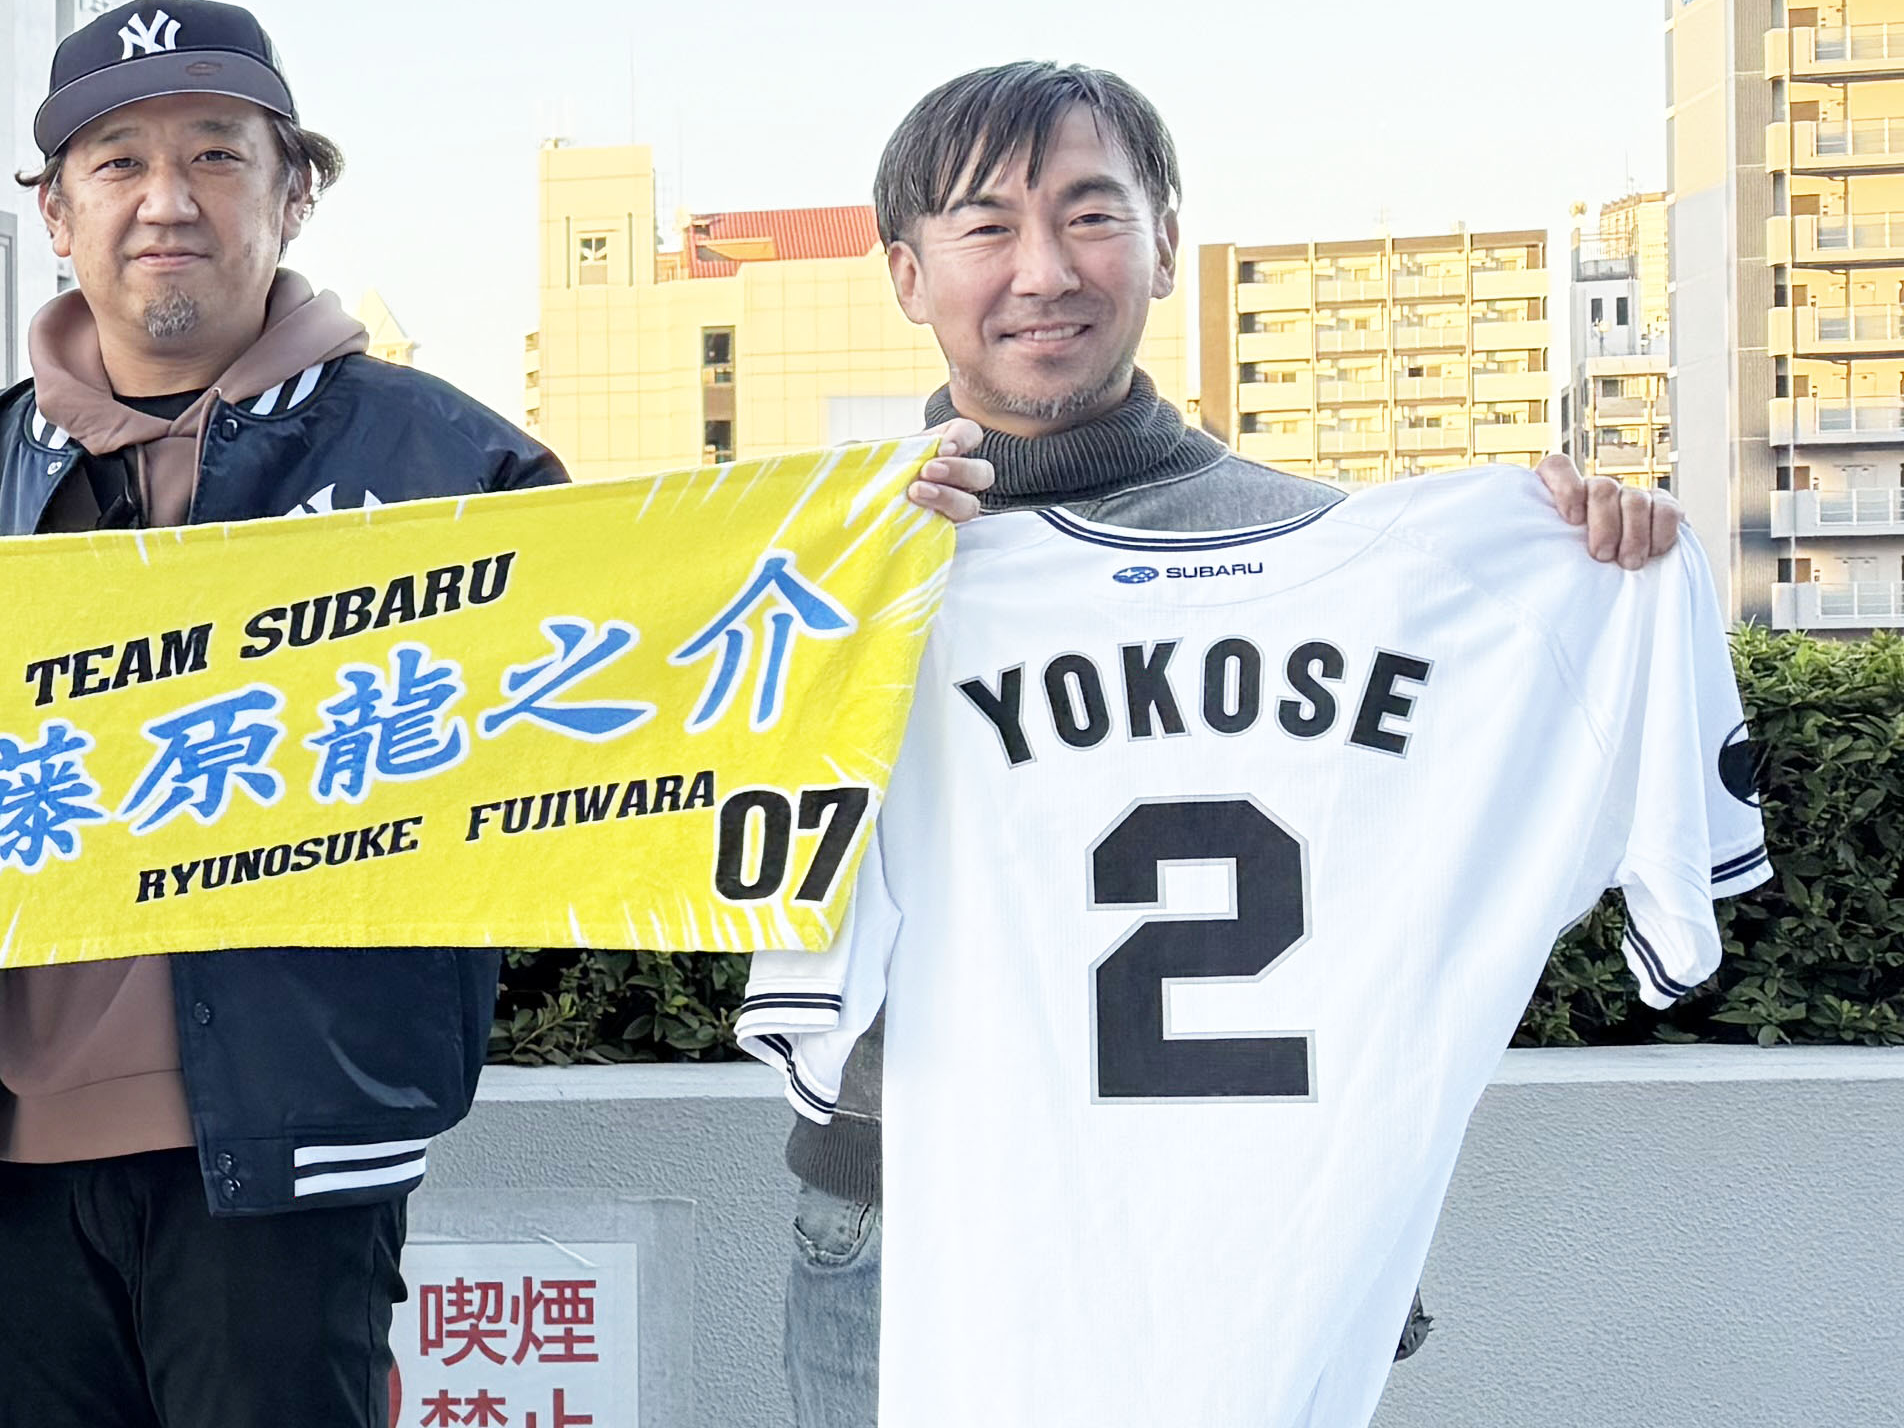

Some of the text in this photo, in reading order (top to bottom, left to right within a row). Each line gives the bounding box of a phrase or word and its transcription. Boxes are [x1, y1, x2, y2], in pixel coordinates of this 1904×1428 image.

[118, 9, 181, 60] NY
[26, 551, 516, 706] TEAM SUBARU
[1166, 562, 1264, 579] SUBARU
[953, 634, 1435, 770] YOKOSE
[135, 770, 714, 903] RYUNOSUKE FUJIWARA
[715, 787, 870, 902] 07
[1085, 792, 1318, 1105] 2
[419, 1276, 599, 1367] 喫煙
